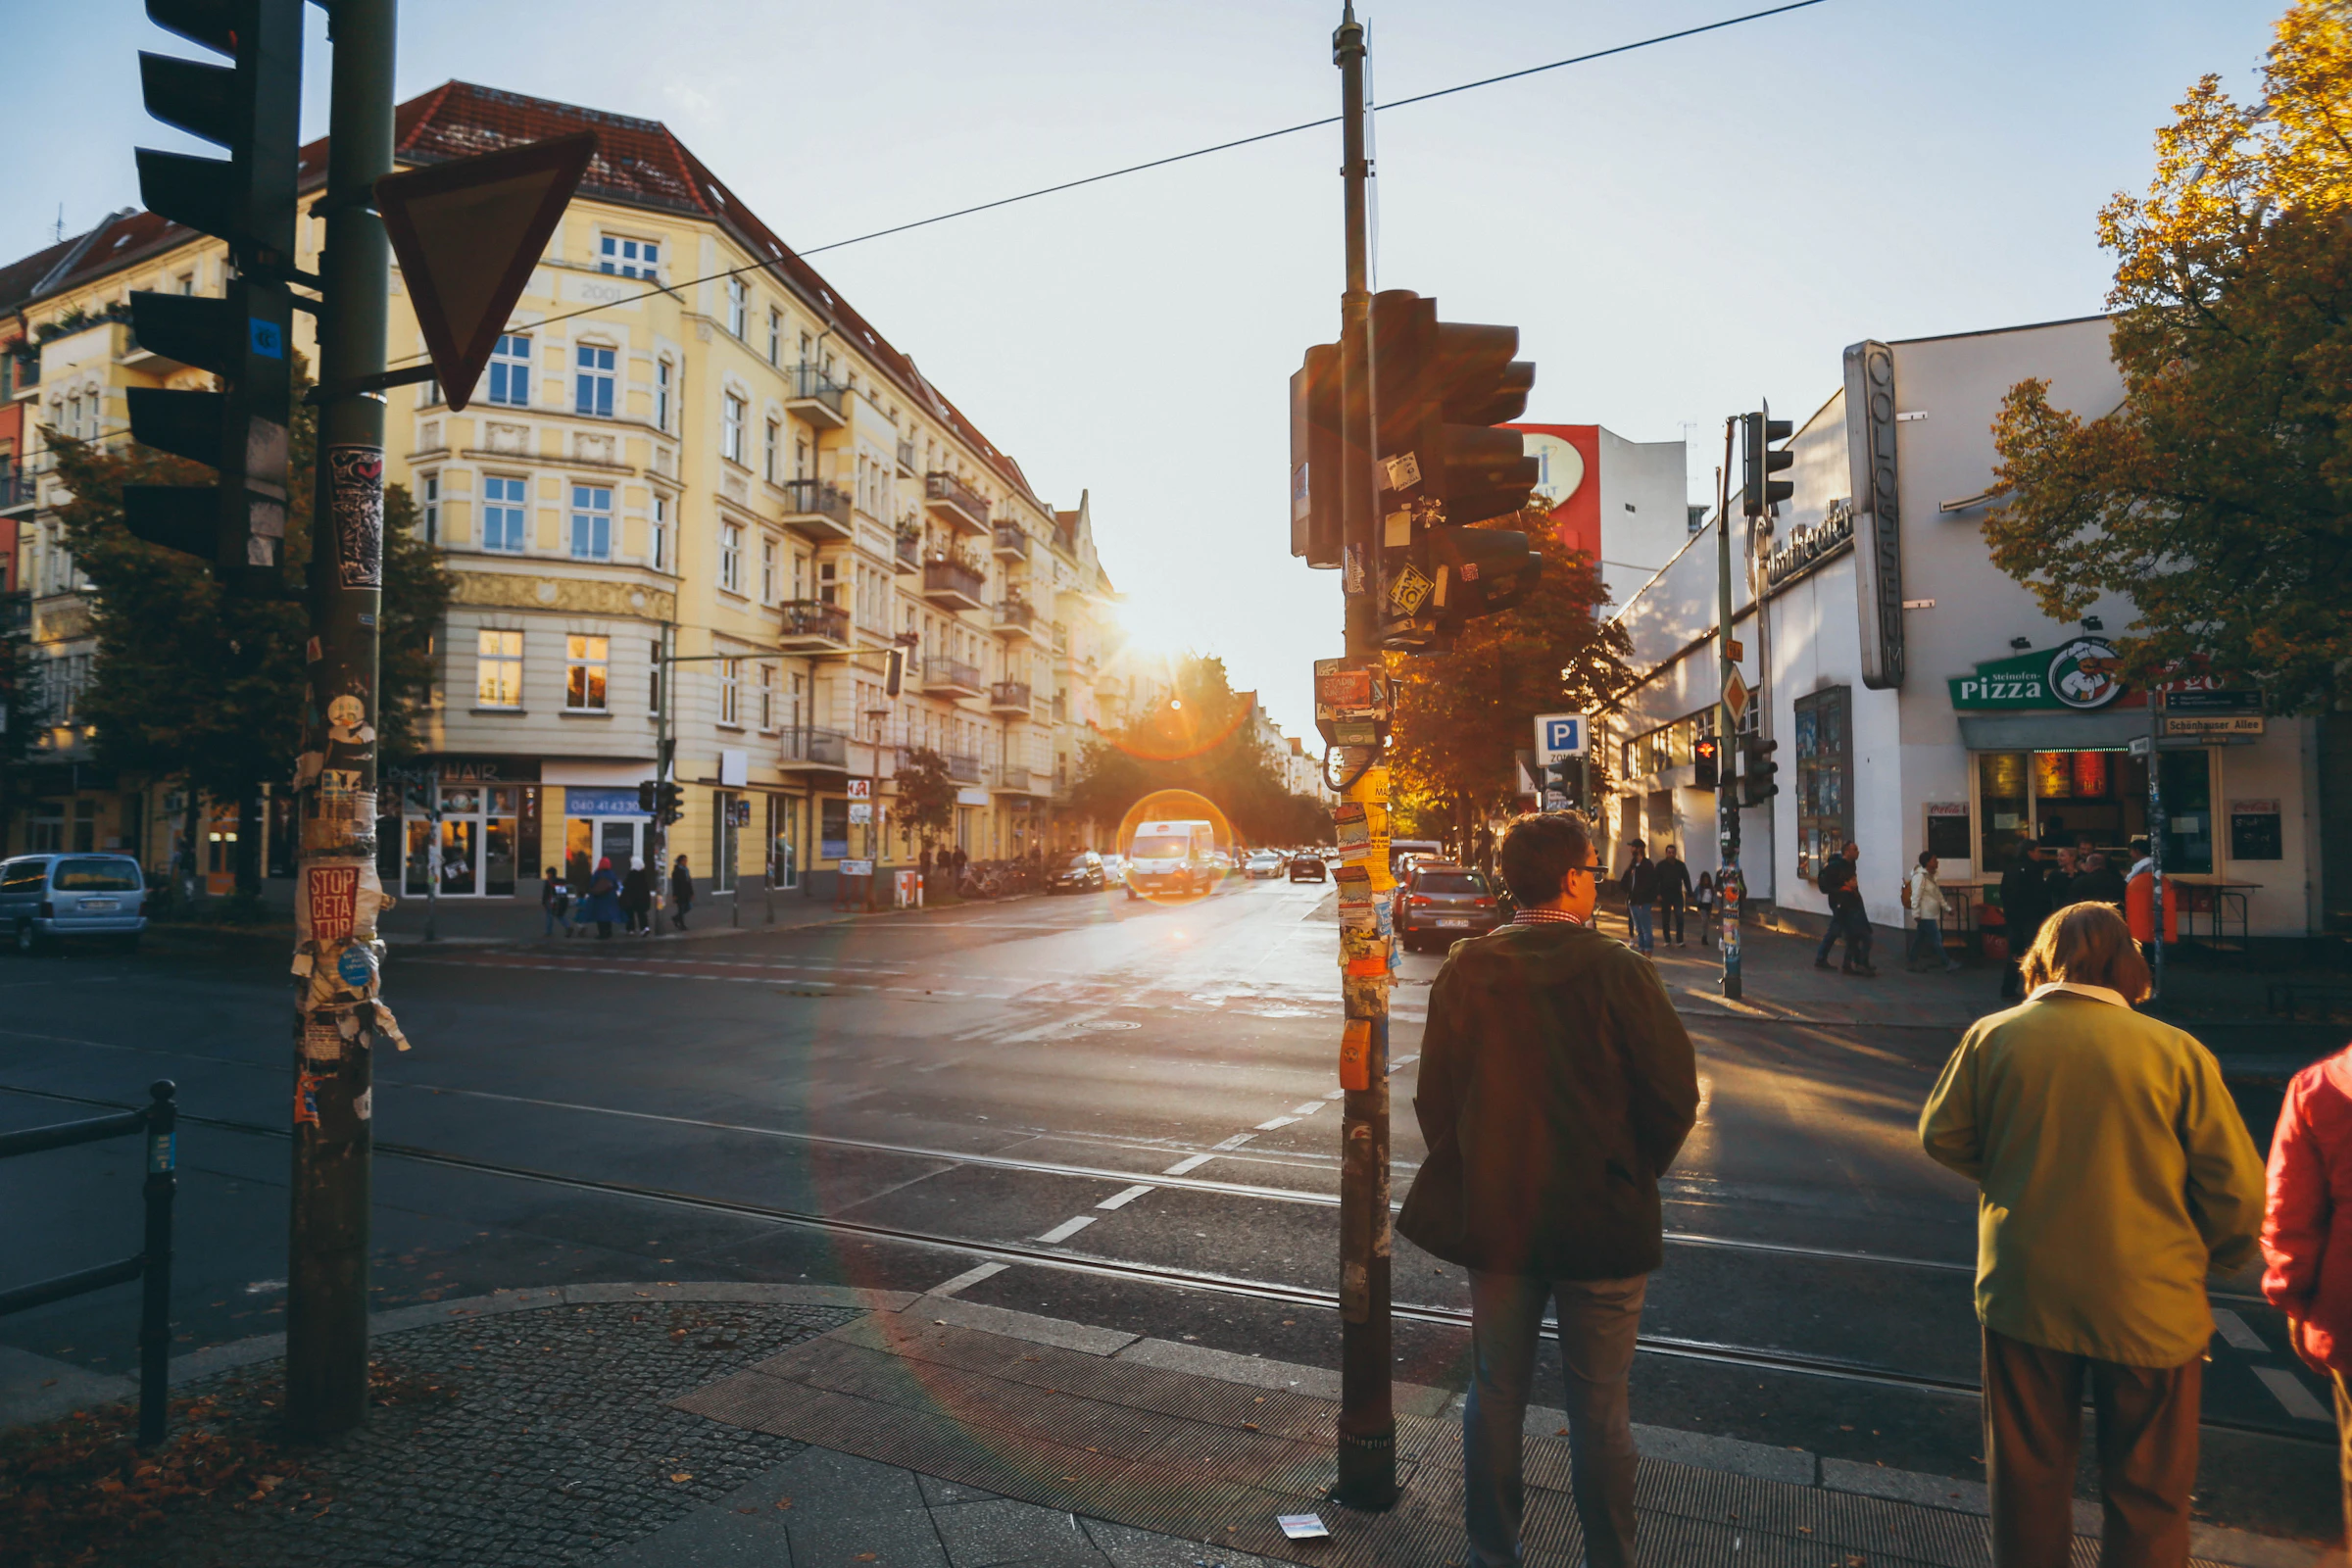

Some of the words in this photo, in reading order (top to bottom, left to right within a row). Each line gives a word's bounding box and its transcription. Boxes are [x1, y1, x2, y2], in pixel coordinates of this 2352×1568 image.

[581, 283, 621, 301] 2001
[1868, 351, 1903, 673] COLOSSEUM
[1992, 672, 2041, 681] Steinofen-
[1961, 677, 2041, 700] Pizza
[2170, 720, 2230, 730] Schönhauser
[2234, 719, 2259, 729] Allee
[1554, 724, 1571, 747] P
[446, 763, 499, 782] HAIR
[571, 800, 594, 811] 040
[312, 871, 355, 894] STOP
[313, 897, 351, 918] CETA
[314, 918, 351, 941] TTIP
